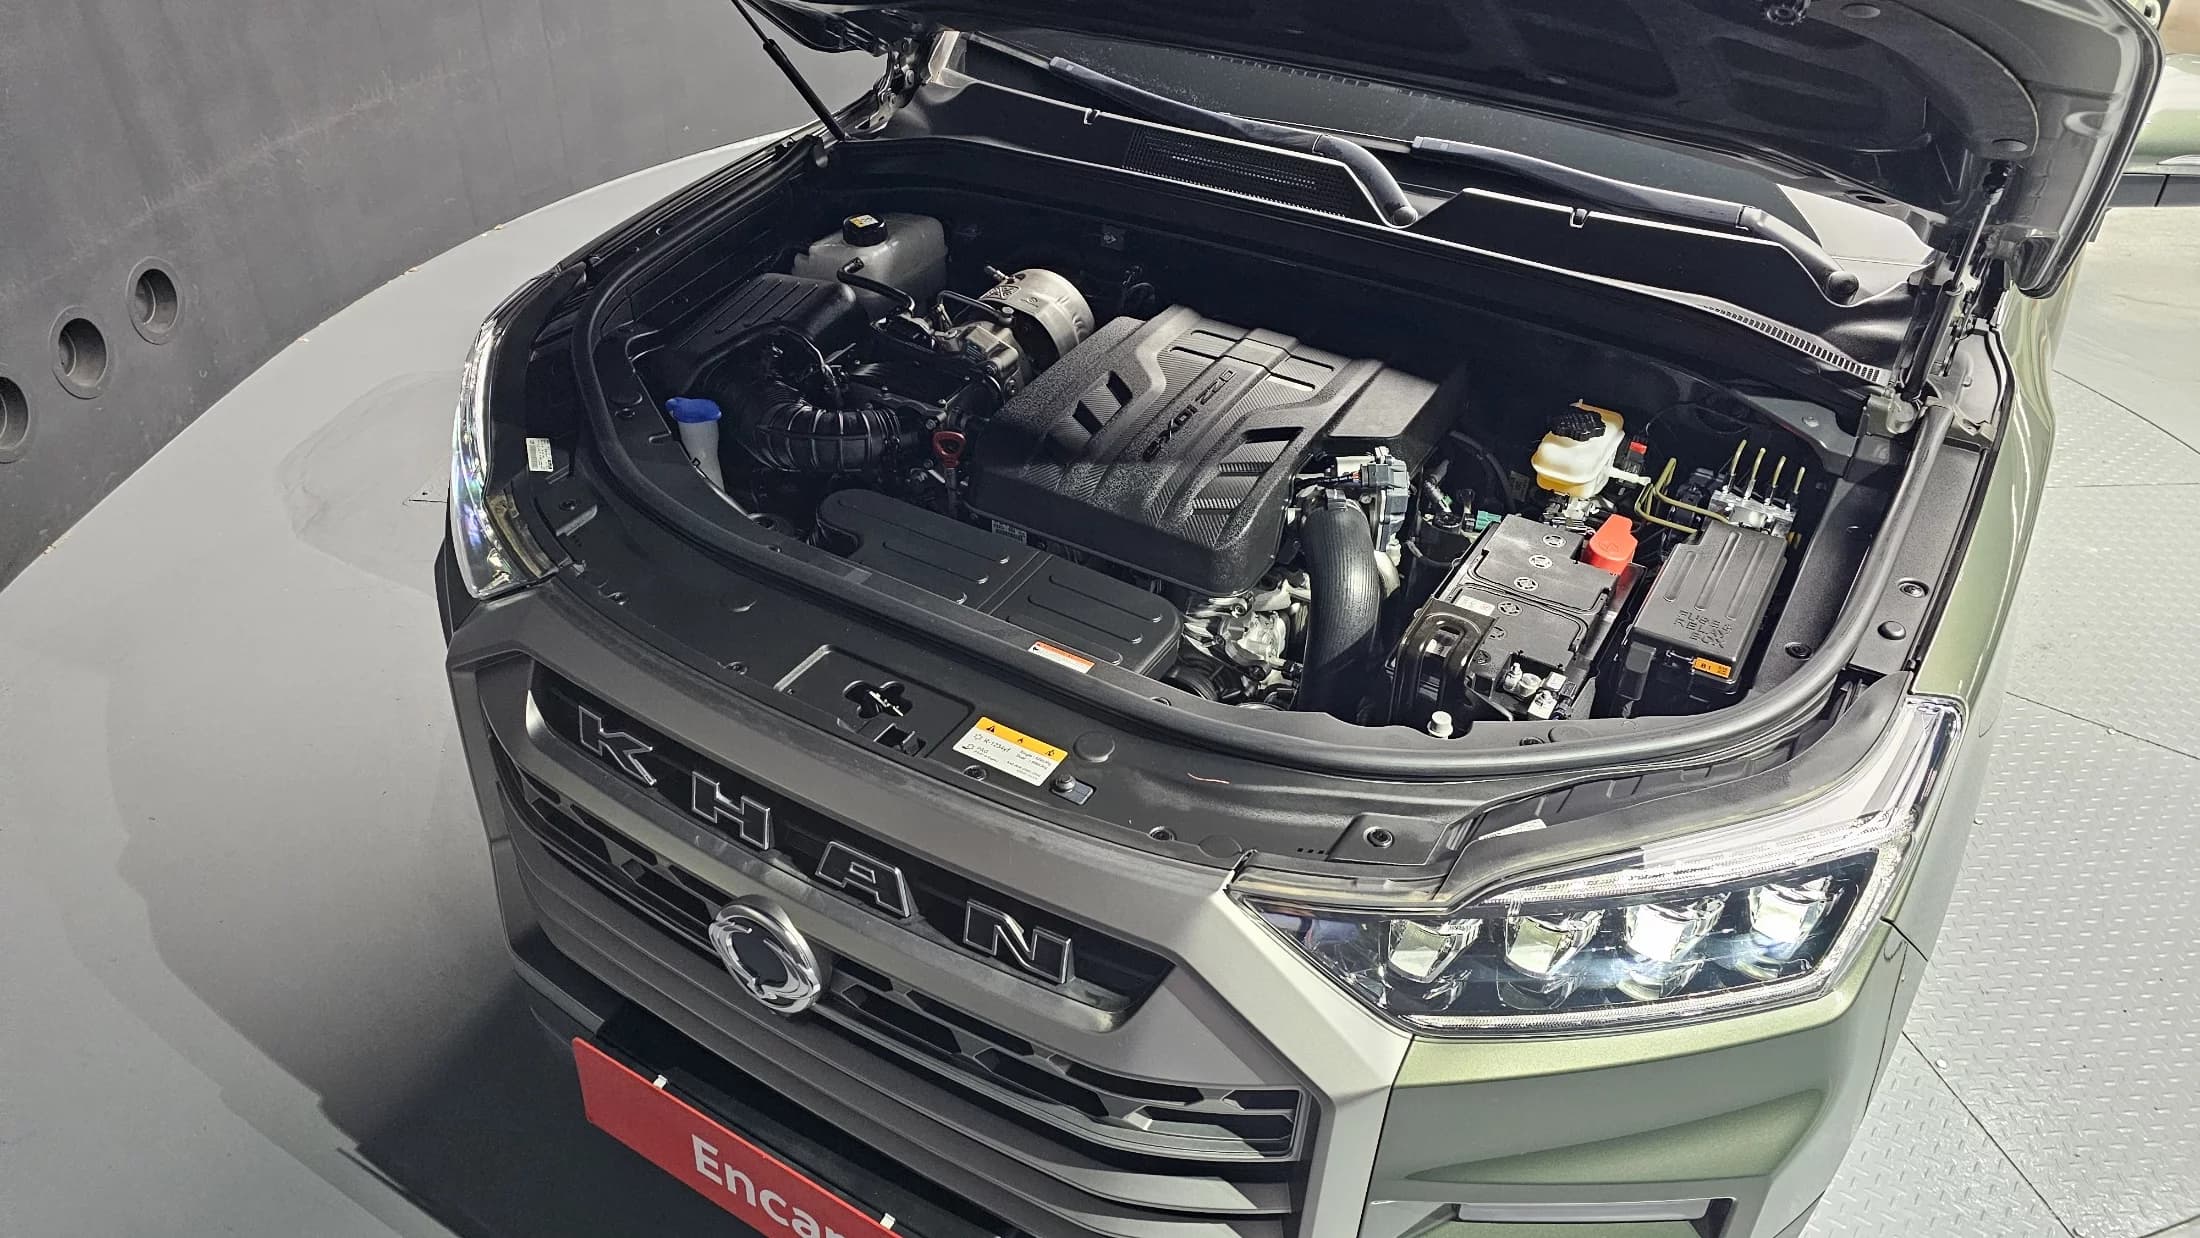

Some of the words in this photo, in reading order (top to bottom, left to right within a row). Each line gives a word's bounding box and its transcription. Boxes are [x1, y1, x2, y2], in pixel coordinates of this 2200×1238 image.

[1195, 368, 1237, 405] 220
[1673, 617, 1729, 639] RELAY
[1689, 631, 1725, 649] BOX
[579, 705, 1072, 986] KHAN
